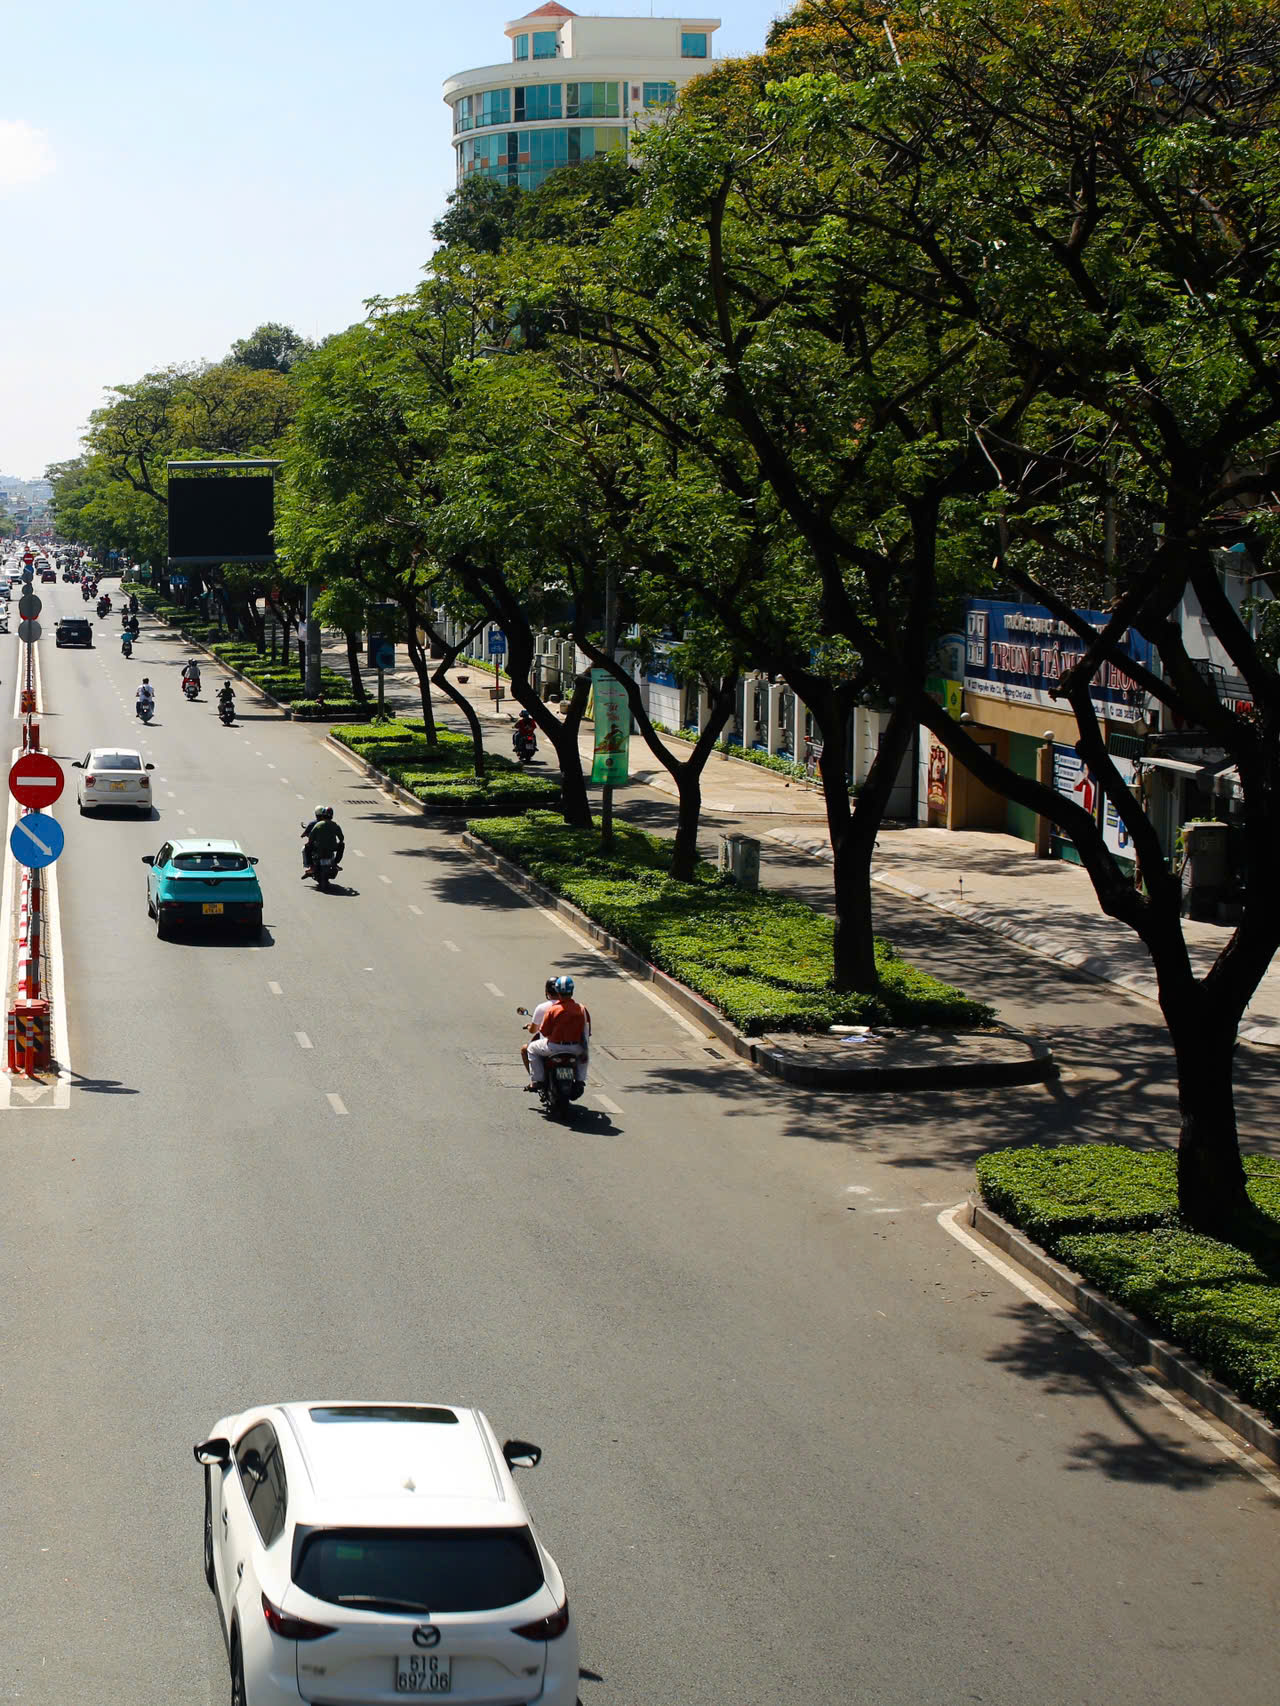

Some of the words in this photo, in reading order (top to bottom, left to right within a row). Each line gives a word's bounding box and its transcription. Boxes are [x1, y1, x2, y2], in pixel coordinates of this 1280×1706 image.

[991, 641, 1040, 676] TRUNG
[410, 1655, 438, 1672] 51G
[399, 1672, 448, 1689] 697.06
